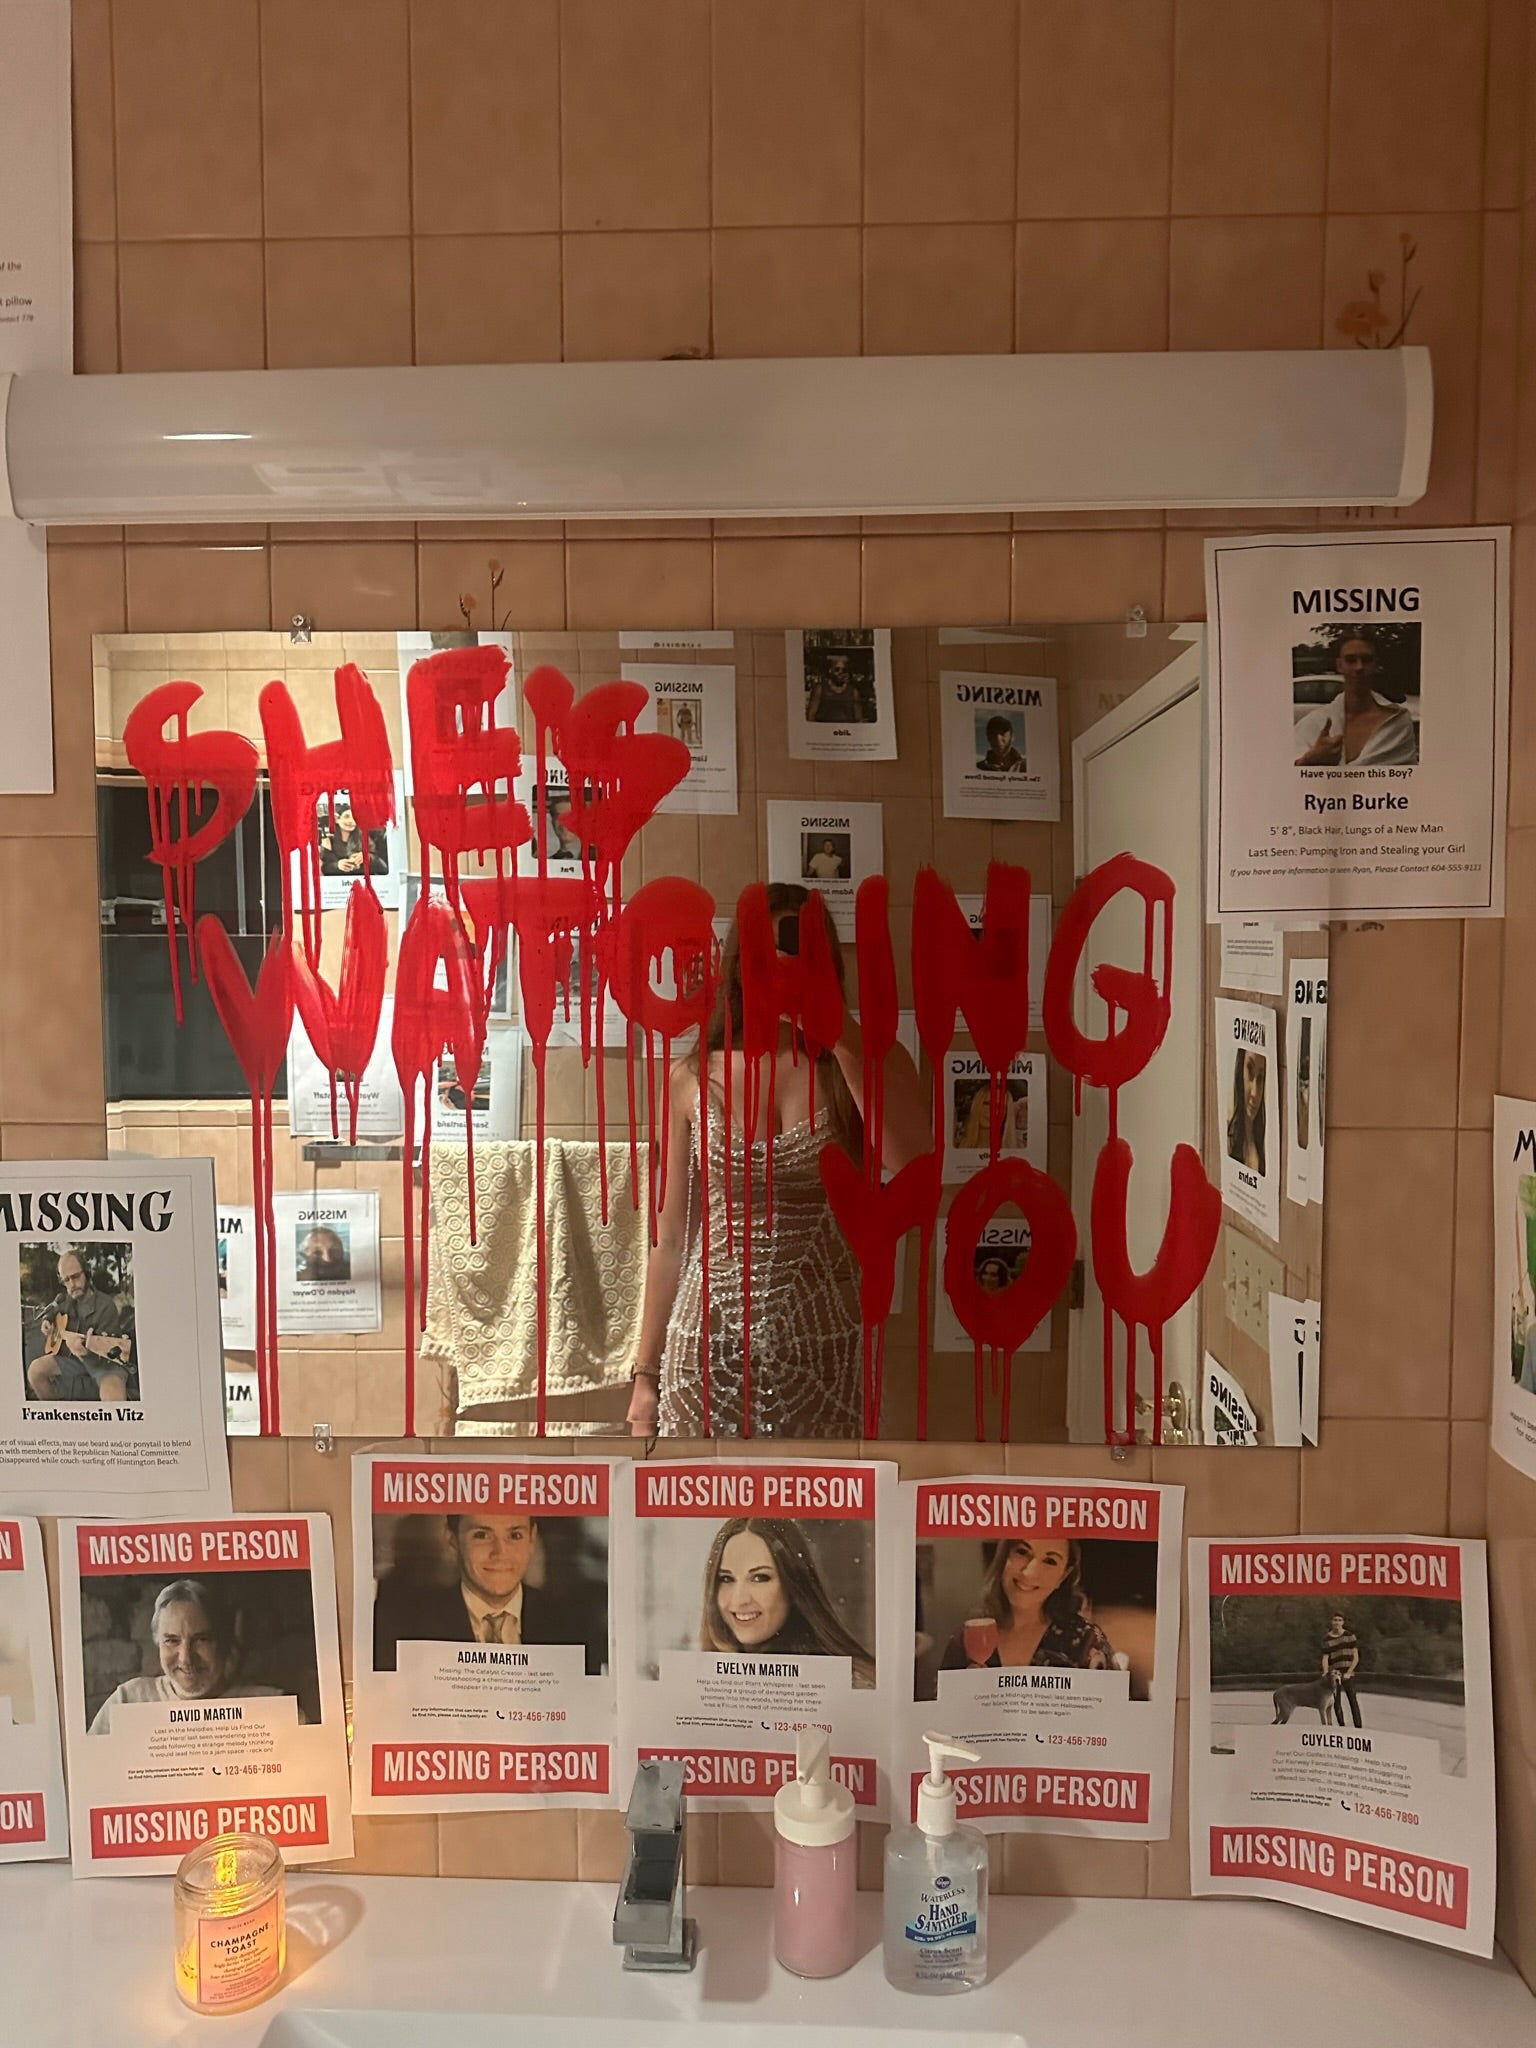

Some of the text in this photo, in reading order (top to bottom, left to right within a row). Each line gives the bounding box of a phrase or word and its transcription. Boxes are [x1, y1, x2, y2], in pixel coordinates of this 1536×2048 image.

[6, 296, 33, 307] pillow
[1293, 587, 1420, 614] MISSING
[1300, 768, 1413, 780] Have you seen this Boy?
[1304, 792, 1409, 814] Ryan Burke
[1298, 826, 1322, 835] Black
[1324, 826, 1344, 836] Hair,
[1345, 826, 1371, 836] Lungs
[1374, 825, 1385, 834] of
[1395, 825, 1418, 833] New
[1421, 824, 1444, 833] Man
[1248, 844, 1465, 858] Last Seen: Pumping Iron and Stealing your Girl
[1230, 869, 1236, 877] If
[1287, 867, 1328, 875] information
[1353, 866, 1373, 874] Ryan,
[818, 1137, 1223, 1350] YOU
[22, 1408, 144, 1421] Frankenstein Vitz
[133, 1440, 161, 1449] ponytail
[73, 1449, 109, 1457] Republican
[117, 1458, 155, 1467] Huntington
[383, 1473, 597, 1505] MISSING PERSON
[647, 1475, 863, 1508] MISSING PERSON
[928, 1494, 1147, 1530] MISSING PERSON
[89, 1529, 299, 1566] MISSING PERSON
[1221, 1553, 1447, 1587] MISSING PERSON
[458, 1651, 528, 1666] ADAM MARTIN
[717, 1662, 799, 1677] EVELYN MARTIN
[998, 1676, 1071, 1689] ERICA MARTIN
[170, 1707, 242, 1722] DAVID MARTIN
[509, 1711, 566, 1721] 123-456-7890
[1048, 1735, 1107, 1746] 123-456-7890
[1302, 1733, 1372, 1752] CUYLER DOM
[225, 1764, 282, 1776] 123-456-7890
[384, 1751, 598, 1782] MISSING PERSON
[650, 1755, 865, 1792] SSING PEON
[951, 1774, 1138, 1809] SSING PERSON
[1354, 1802, 1419, 1825] 123-456-7890
[103, 1803, 316, 1845] MISSING PERSON
[1222, 1833, 1455, 1909] MISSING PERSON
[921, 1887, 966, 1903] WATERLESS
[929, 1903, 959, 1920] HAND
[914, 1911, 968, 1933] SANITIZER
[210, 1922, 269, 1948] CHAMPAGNE
[226, 1939, 257, 1955] TOAST
